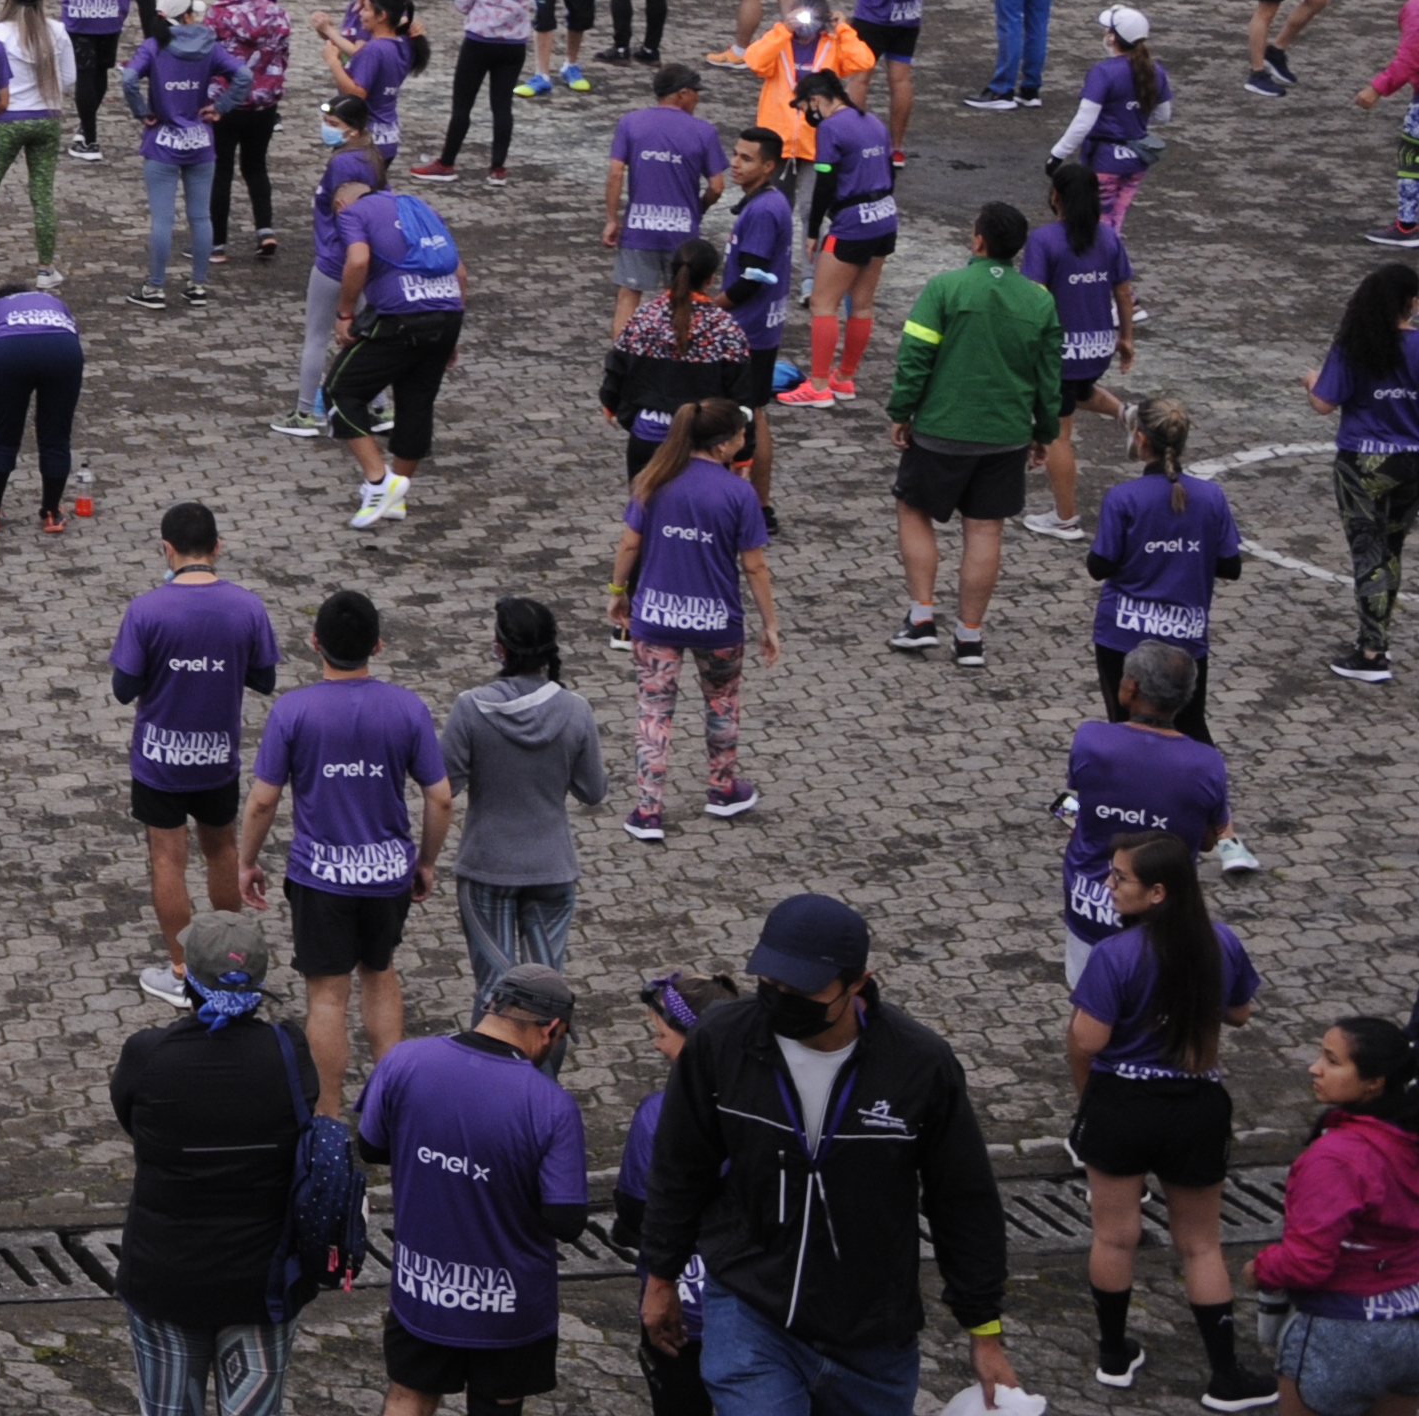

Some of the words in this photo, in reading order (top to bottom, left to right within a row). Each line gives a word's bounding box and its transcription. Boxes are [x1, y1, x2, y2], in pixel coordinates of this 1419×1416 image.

[641, 150, 671, 162] enel
[628, 217, 643, 230] LA
[645, 219, 691, 233] NOCHE
[1068, 272, 1096, 284] enel
[662, 525, 699, 540] enel
[1145, 538, 1182, 553] enel
[644, 588, 728, 613] ILUMINA
[1117, 594, 1205, 625] ILUMINA
[641, 604, 661, 625] LA
[667, 613, 728, 630] NOCHE
[1116, 614, 1139, 632] LA
[1148, 620, 1205, 639] NOCHE
[169, 656, 208, 671] enel
[144, 724, 230, 753] ILUMINA
[142, 741, 164, 764] LA
[166, 746, 229, 765] NOCHE
[323, 760, 364, 778] enel
[1096, 805, 1144, 825] enel
[310, 840, 407, 868] ILUMINA
[310, 858, 337, 884] LA
[340, 861, 408, 885] NOCHE
[418, 1146, 468, 1175] enel
[397, 1243, 516, 1293] ILUMINA
[397, 1264, 417, 1298] LA
[421, 1281, 516, 1313] NOCHE
